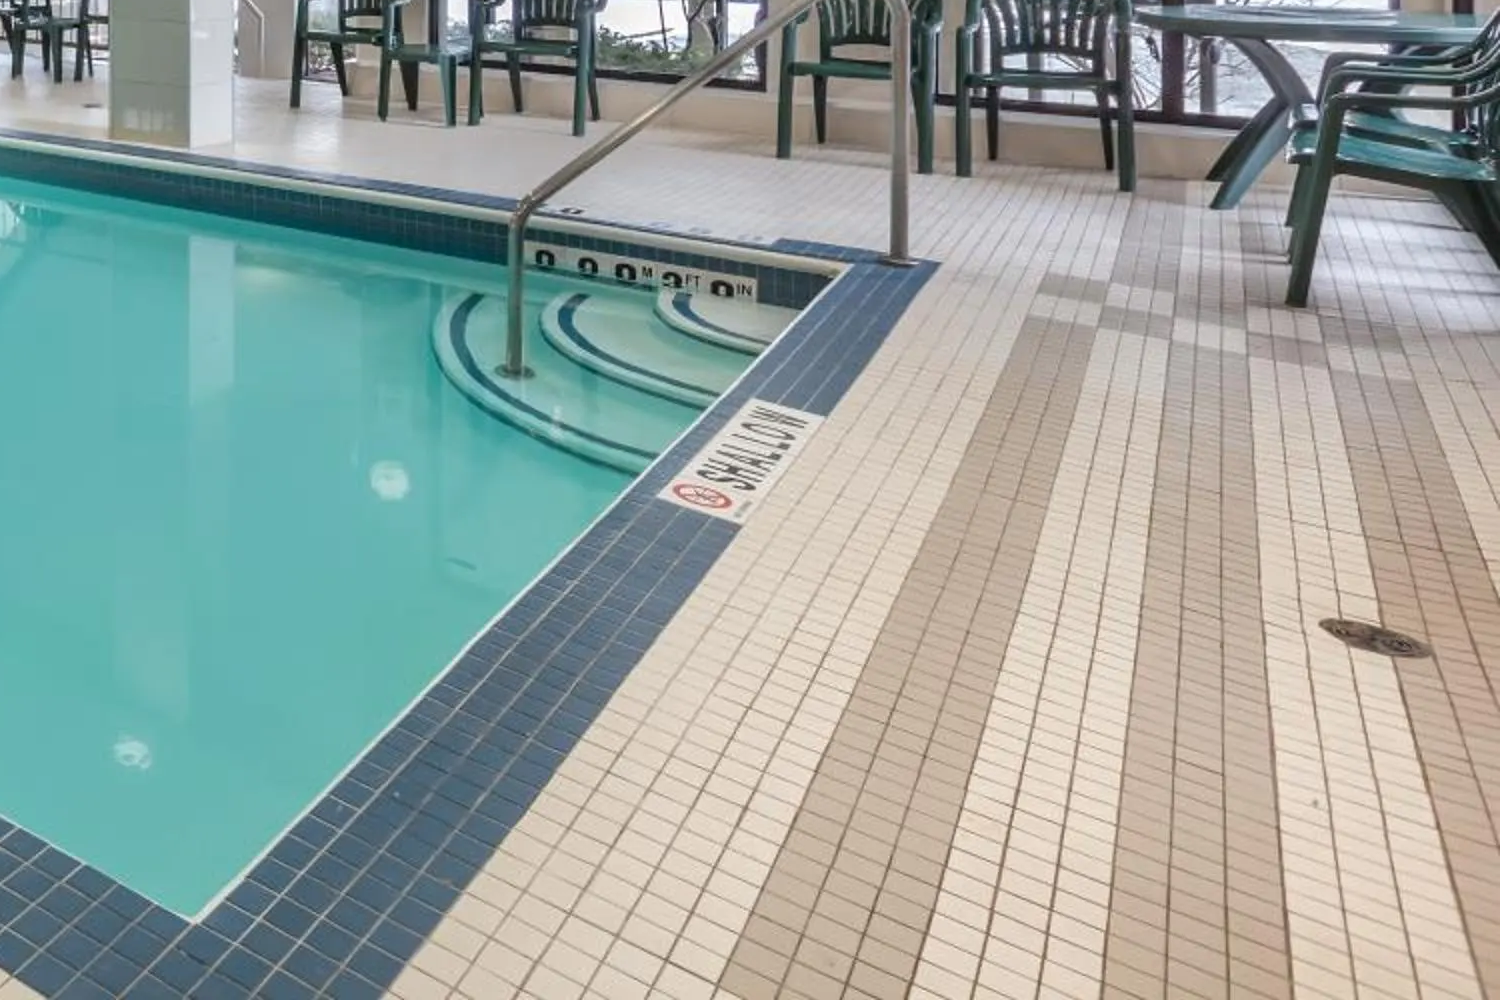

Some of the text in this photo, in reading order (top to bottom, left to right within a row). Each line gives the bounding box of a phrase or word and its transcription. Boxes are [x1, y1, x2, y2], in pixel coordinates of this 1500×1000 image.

[685, 273, 702, 289] FT
[737, 284, 753, 297] IN
[696, 406, 809, 491] SHALLOW
